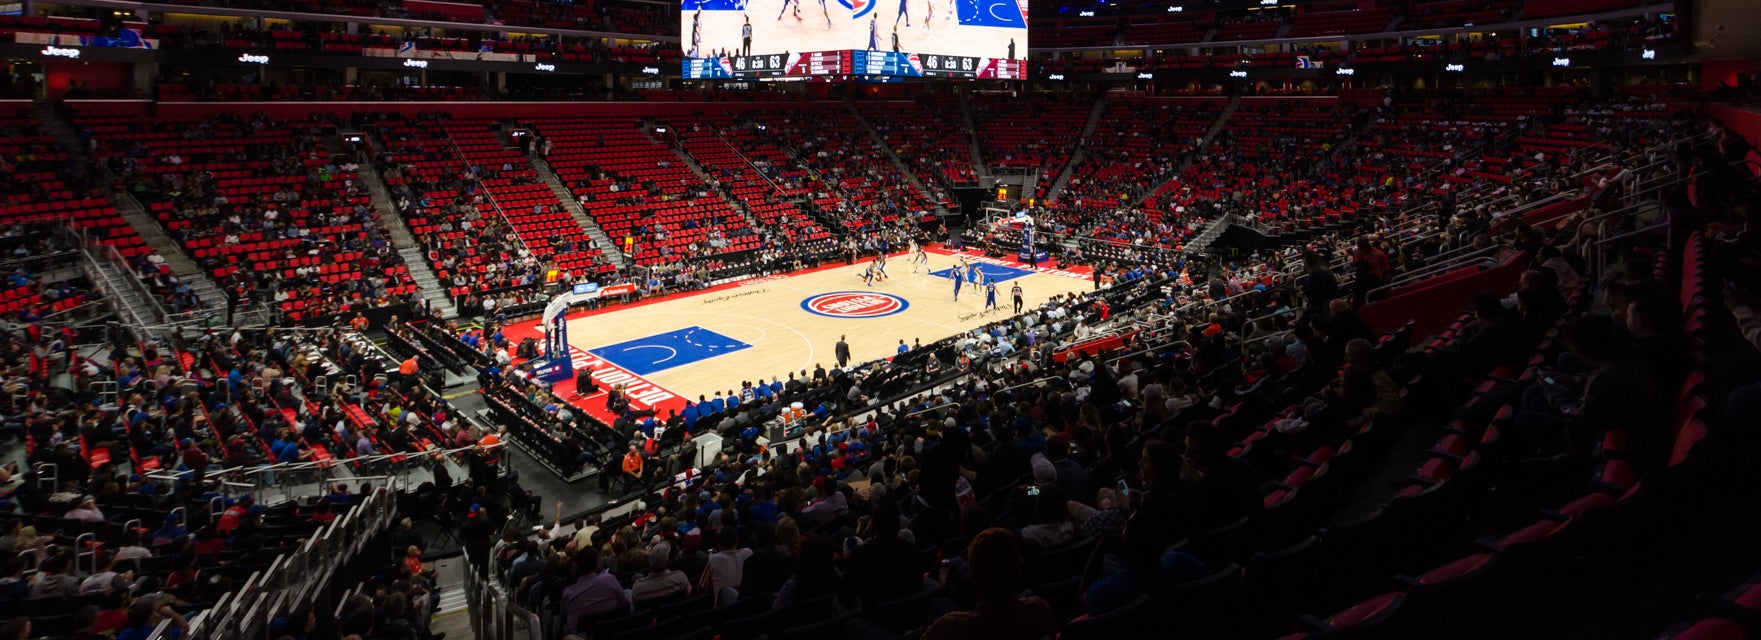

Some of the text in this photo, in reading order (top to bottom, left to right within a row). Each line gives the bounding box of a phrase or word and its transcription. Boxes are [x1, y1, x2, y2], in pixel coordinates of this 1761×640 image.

[41, 45, 81, 59] Jeep
[238, 53, 270, 64] Jeep
[402, 56, 428, 69] Jeep
[735, 57, 746, 70] 46
[752, 59, 764, 69] 8:38
[769, 55, 780, 69] 63
[926, 55, 938, 69] 46
[962, 57, 973, 70] 63
[1553, 58, 1570, 68] Jeep
[533, 61, 556, 72] Jeep
[944, 60, 956, 69] 8:38
[1446, 63, 1464, 73] Jeep
[643, 67, 660, 76] Jeep
[1337, 67, 1354, 76] Jeep
[591, 367, 675, 406] DETROIT
